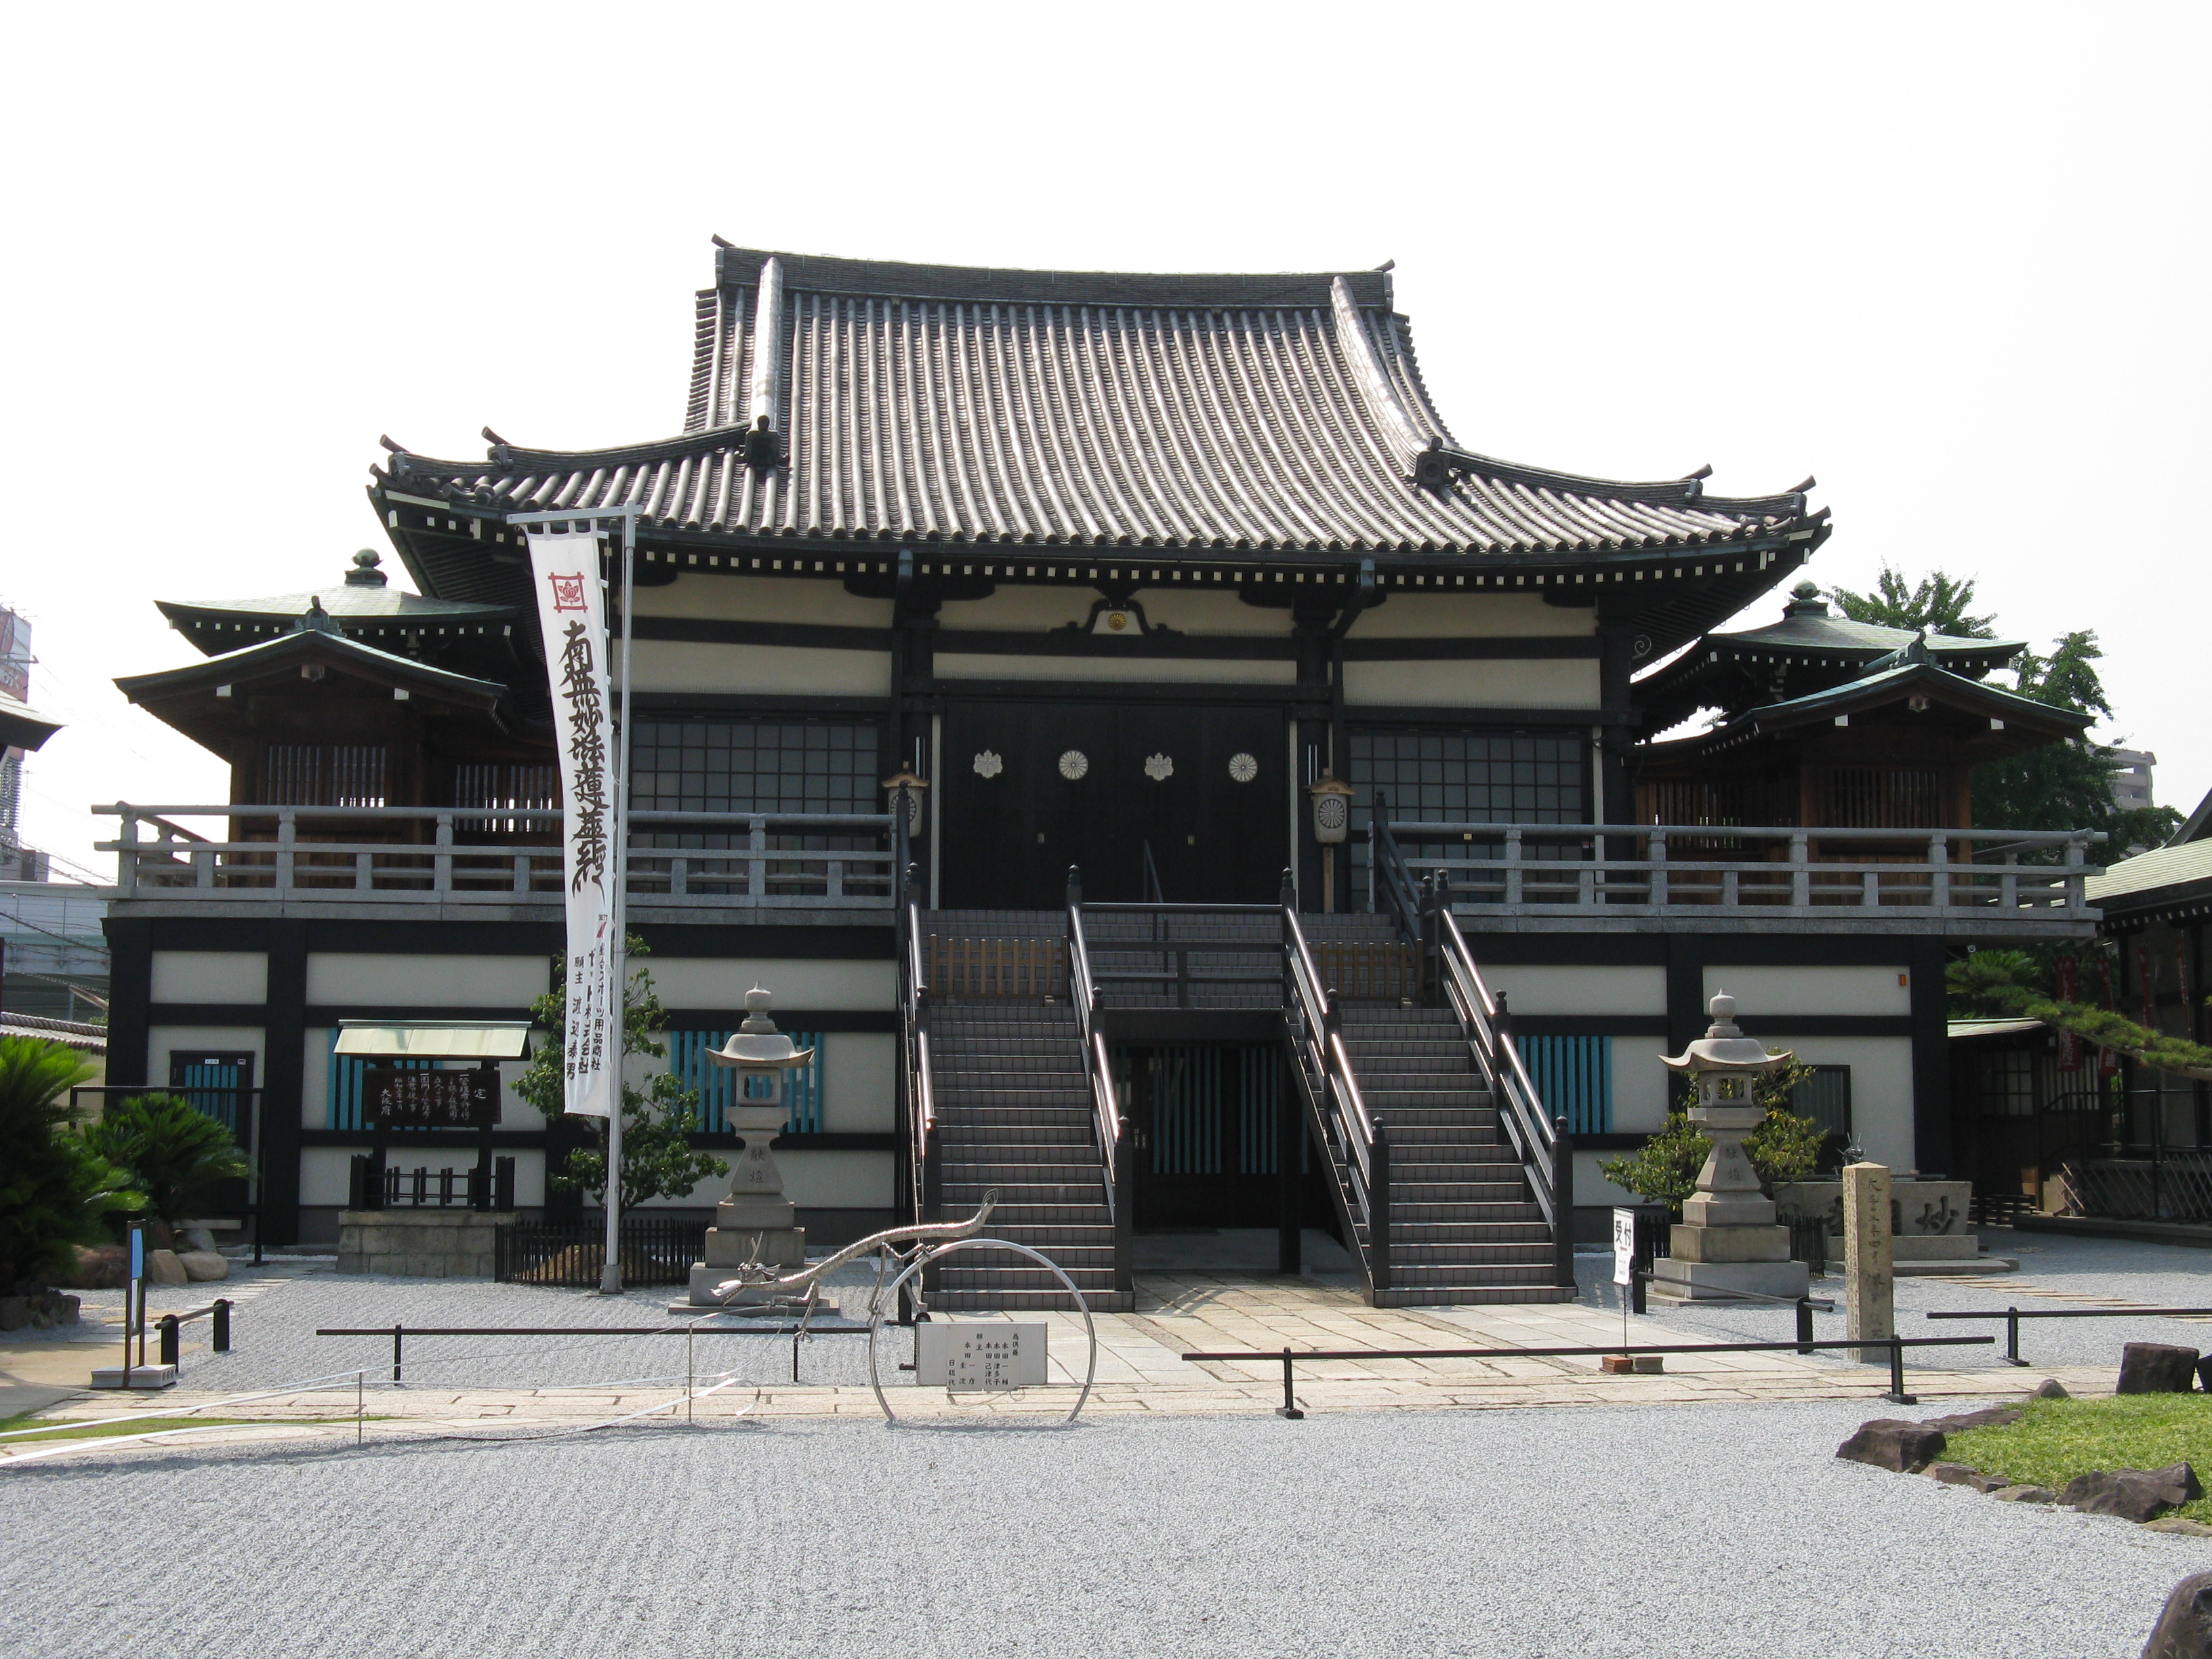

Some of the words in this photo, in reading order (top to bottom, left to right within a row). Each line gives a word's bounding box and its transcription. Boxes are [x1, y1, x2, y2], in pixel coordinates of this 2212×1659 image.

[380, 1088, 392, 1116] 大阪府
[1615, 1220, 1632, 1247] 受付
